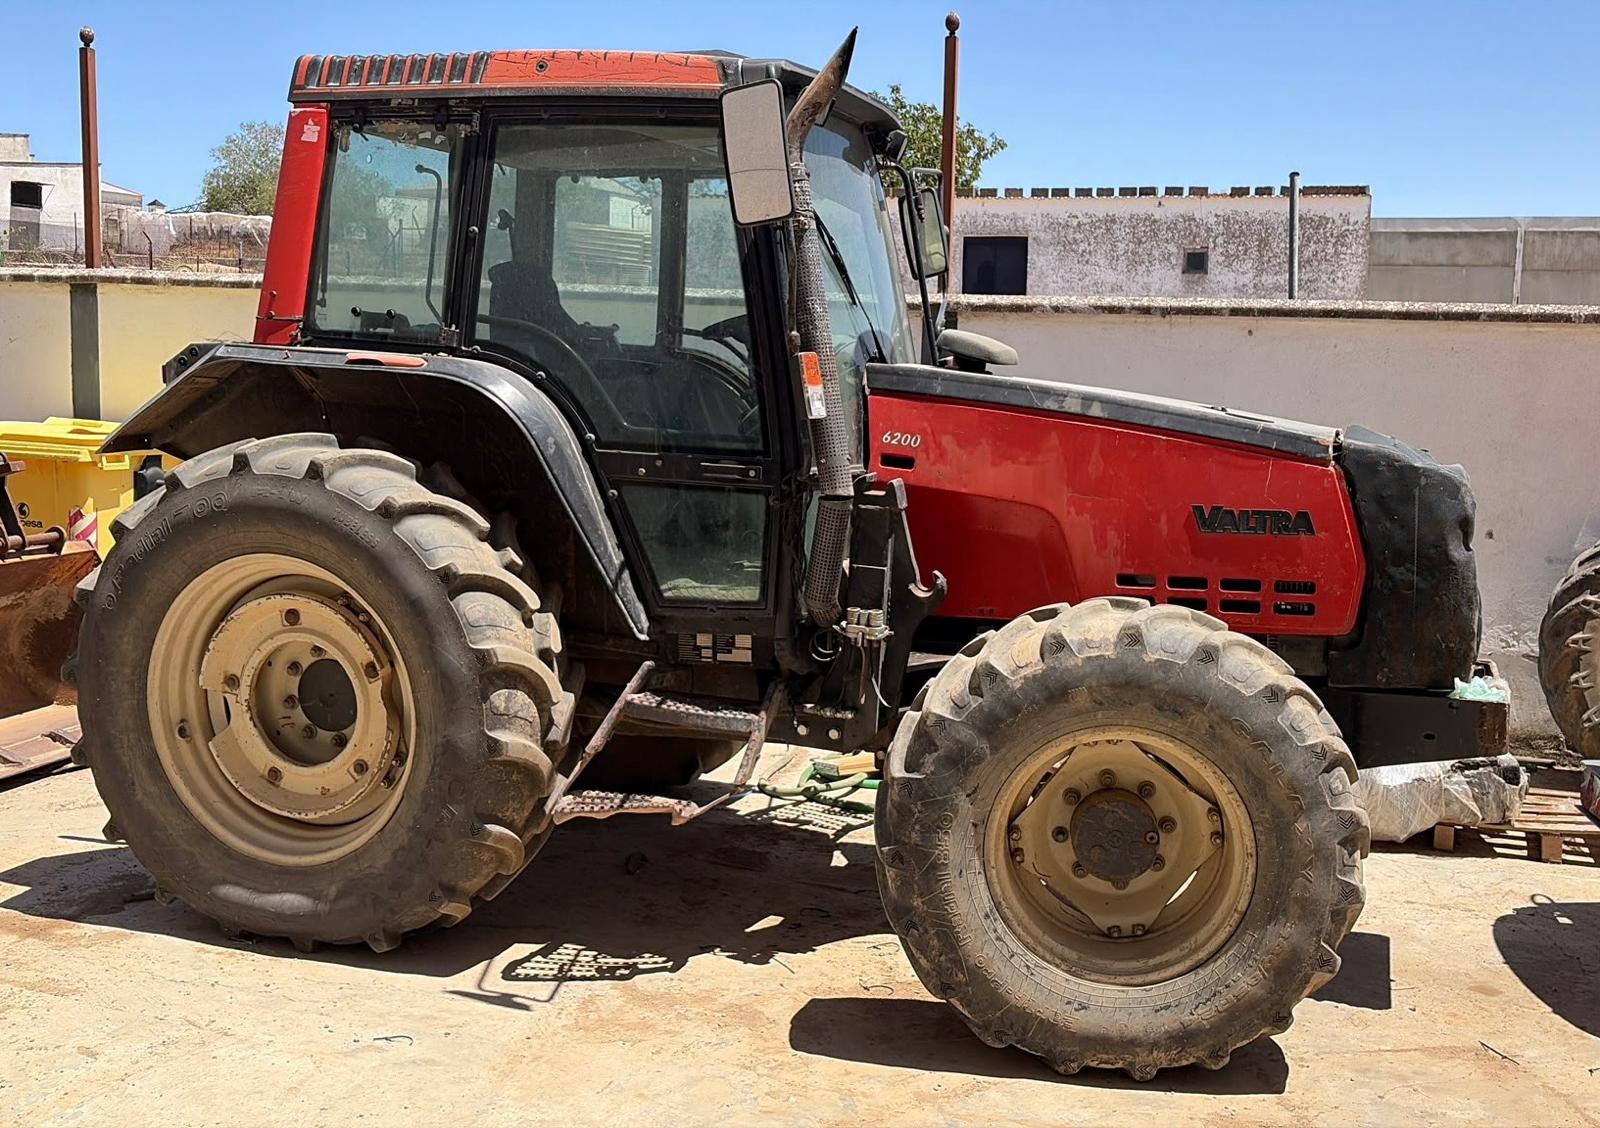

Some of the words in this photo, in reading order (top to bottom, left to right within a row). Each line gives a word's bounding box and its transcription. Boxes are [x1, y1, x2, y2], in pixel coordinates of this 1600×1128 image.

[882, 431, 921, 447] 6200
[1191, 504, 1317, 536] VALTRA
[1230, 717, 1314, 882] GALAXY
[935, 811, 955, 863] 850
[937, 871, 972, 946] Radial
